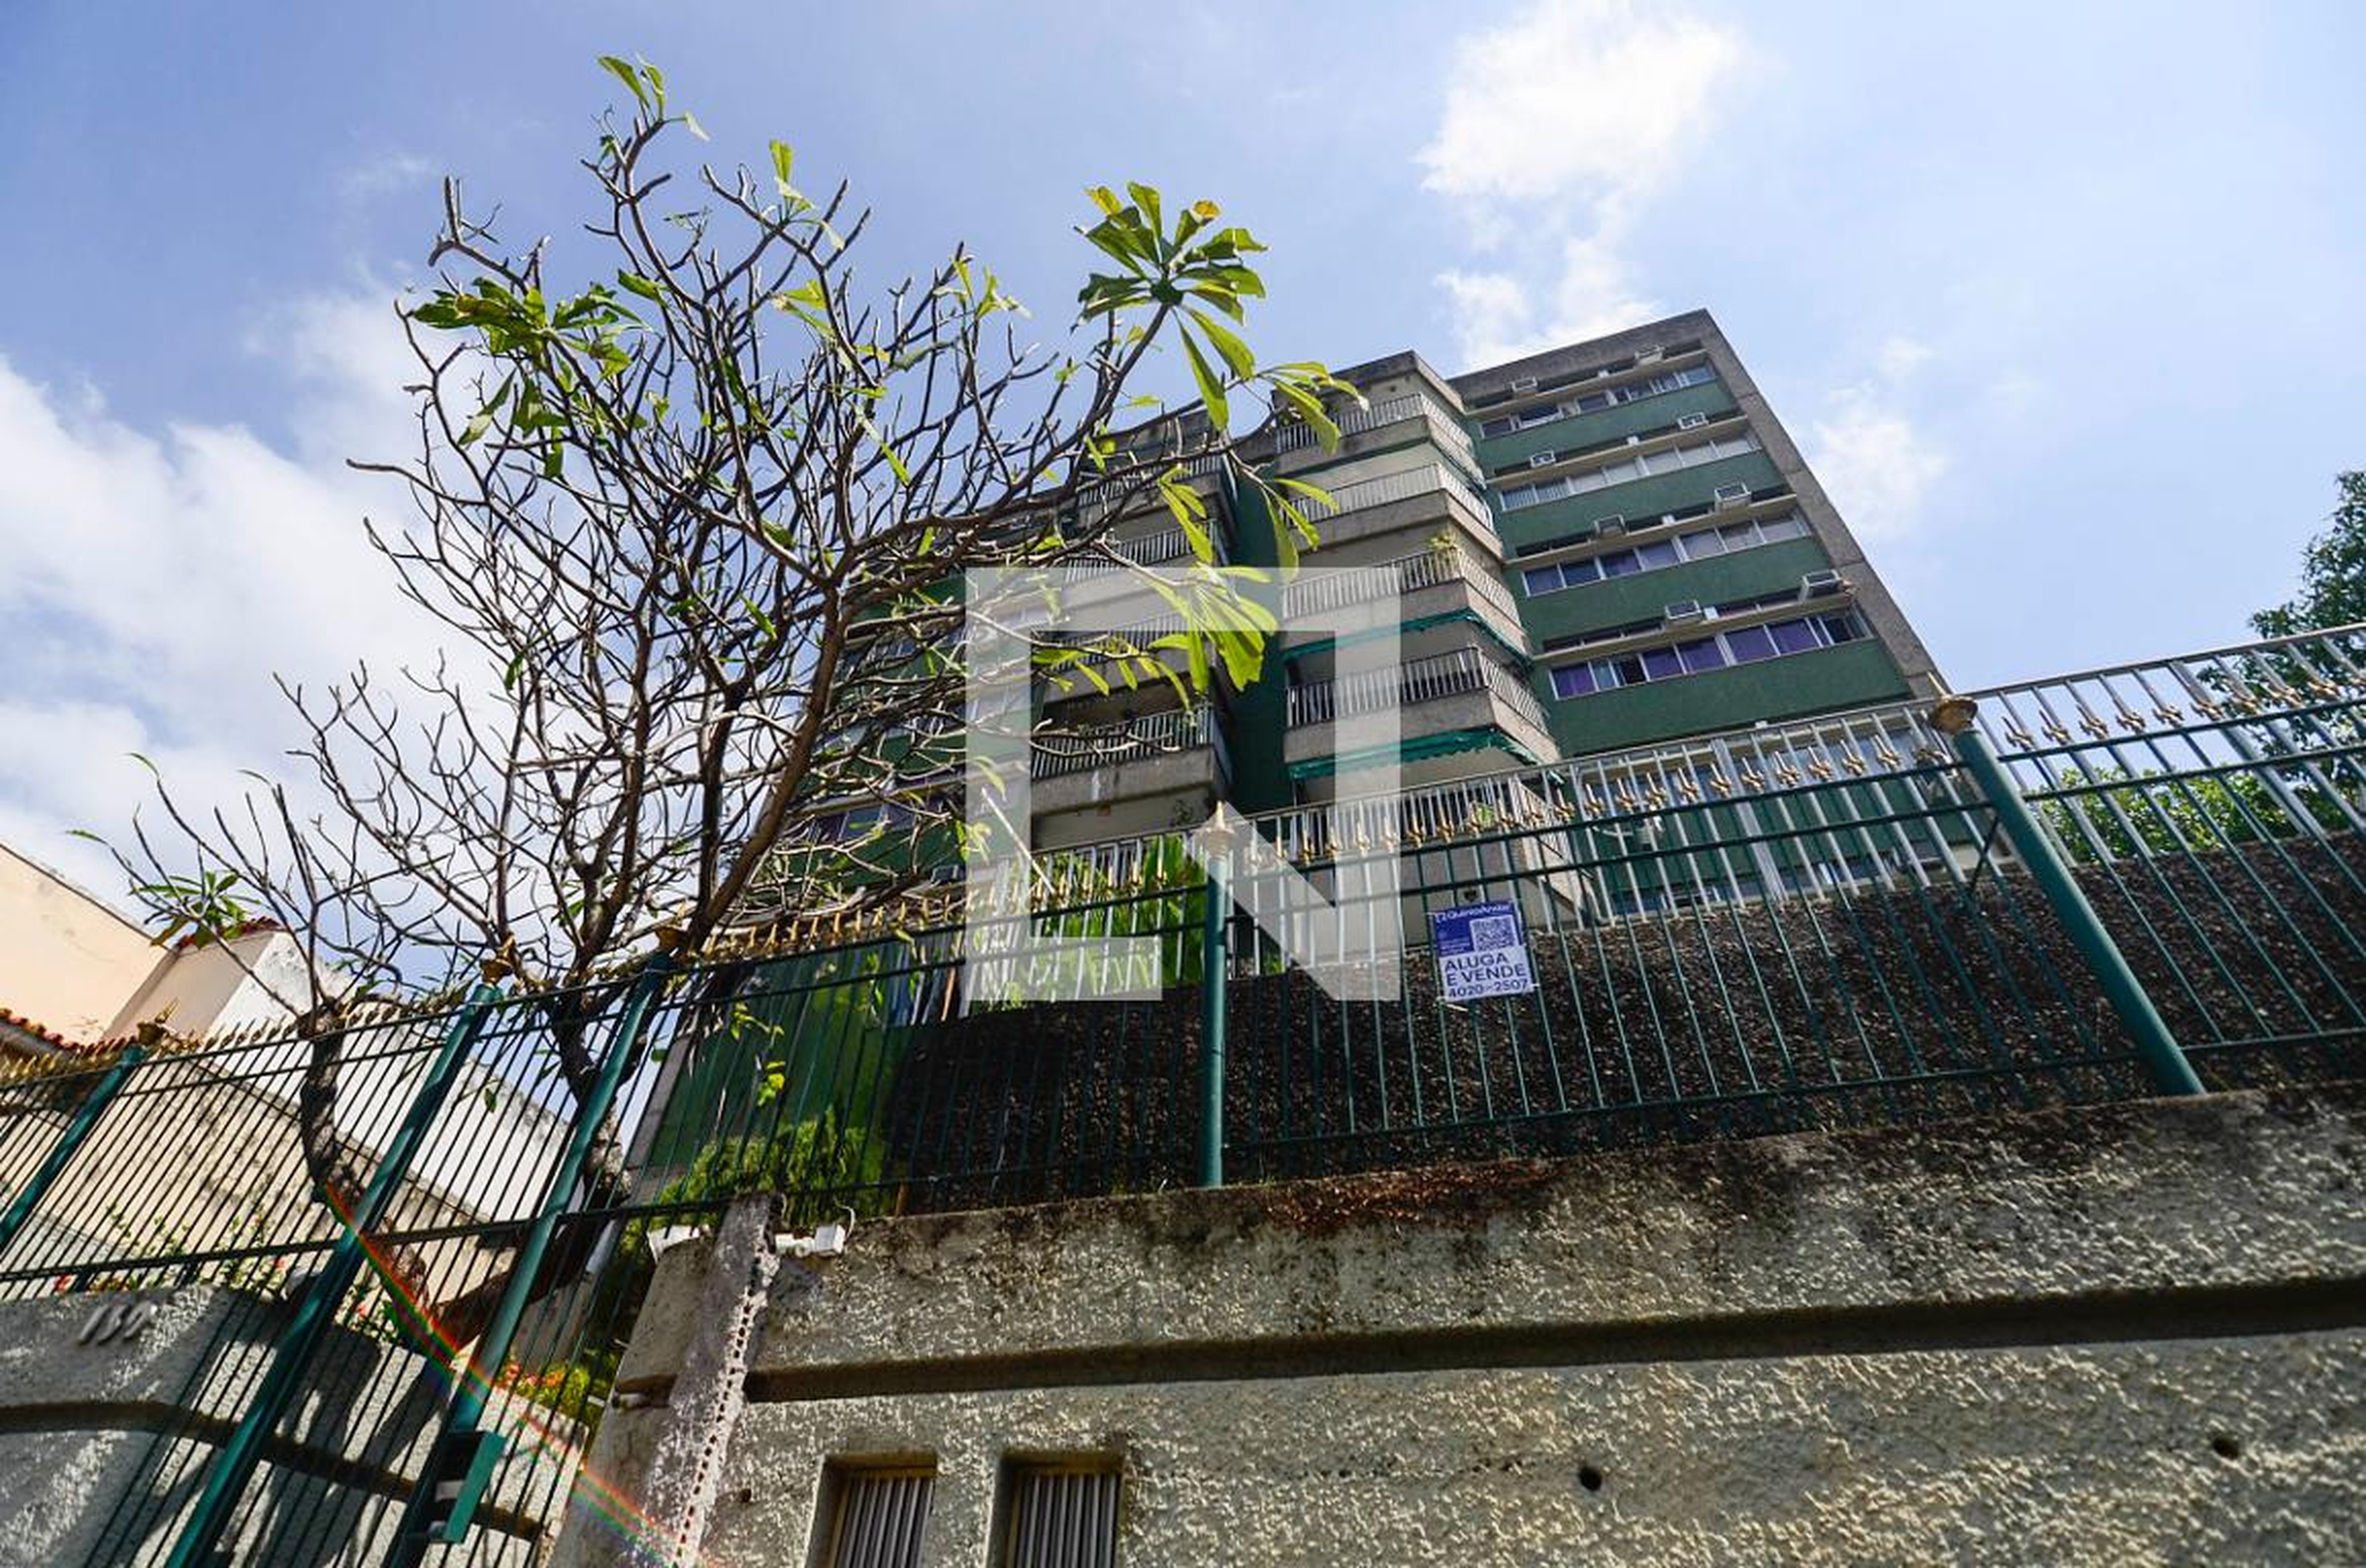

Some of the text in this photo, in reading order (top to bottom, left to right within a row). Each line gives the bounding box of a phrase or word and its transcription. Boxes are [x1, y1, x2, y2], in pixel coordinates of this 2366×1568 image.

[1445, 953, 1508, 972] ALUGA
[1447, 964, 1526, 986] E VENDE
